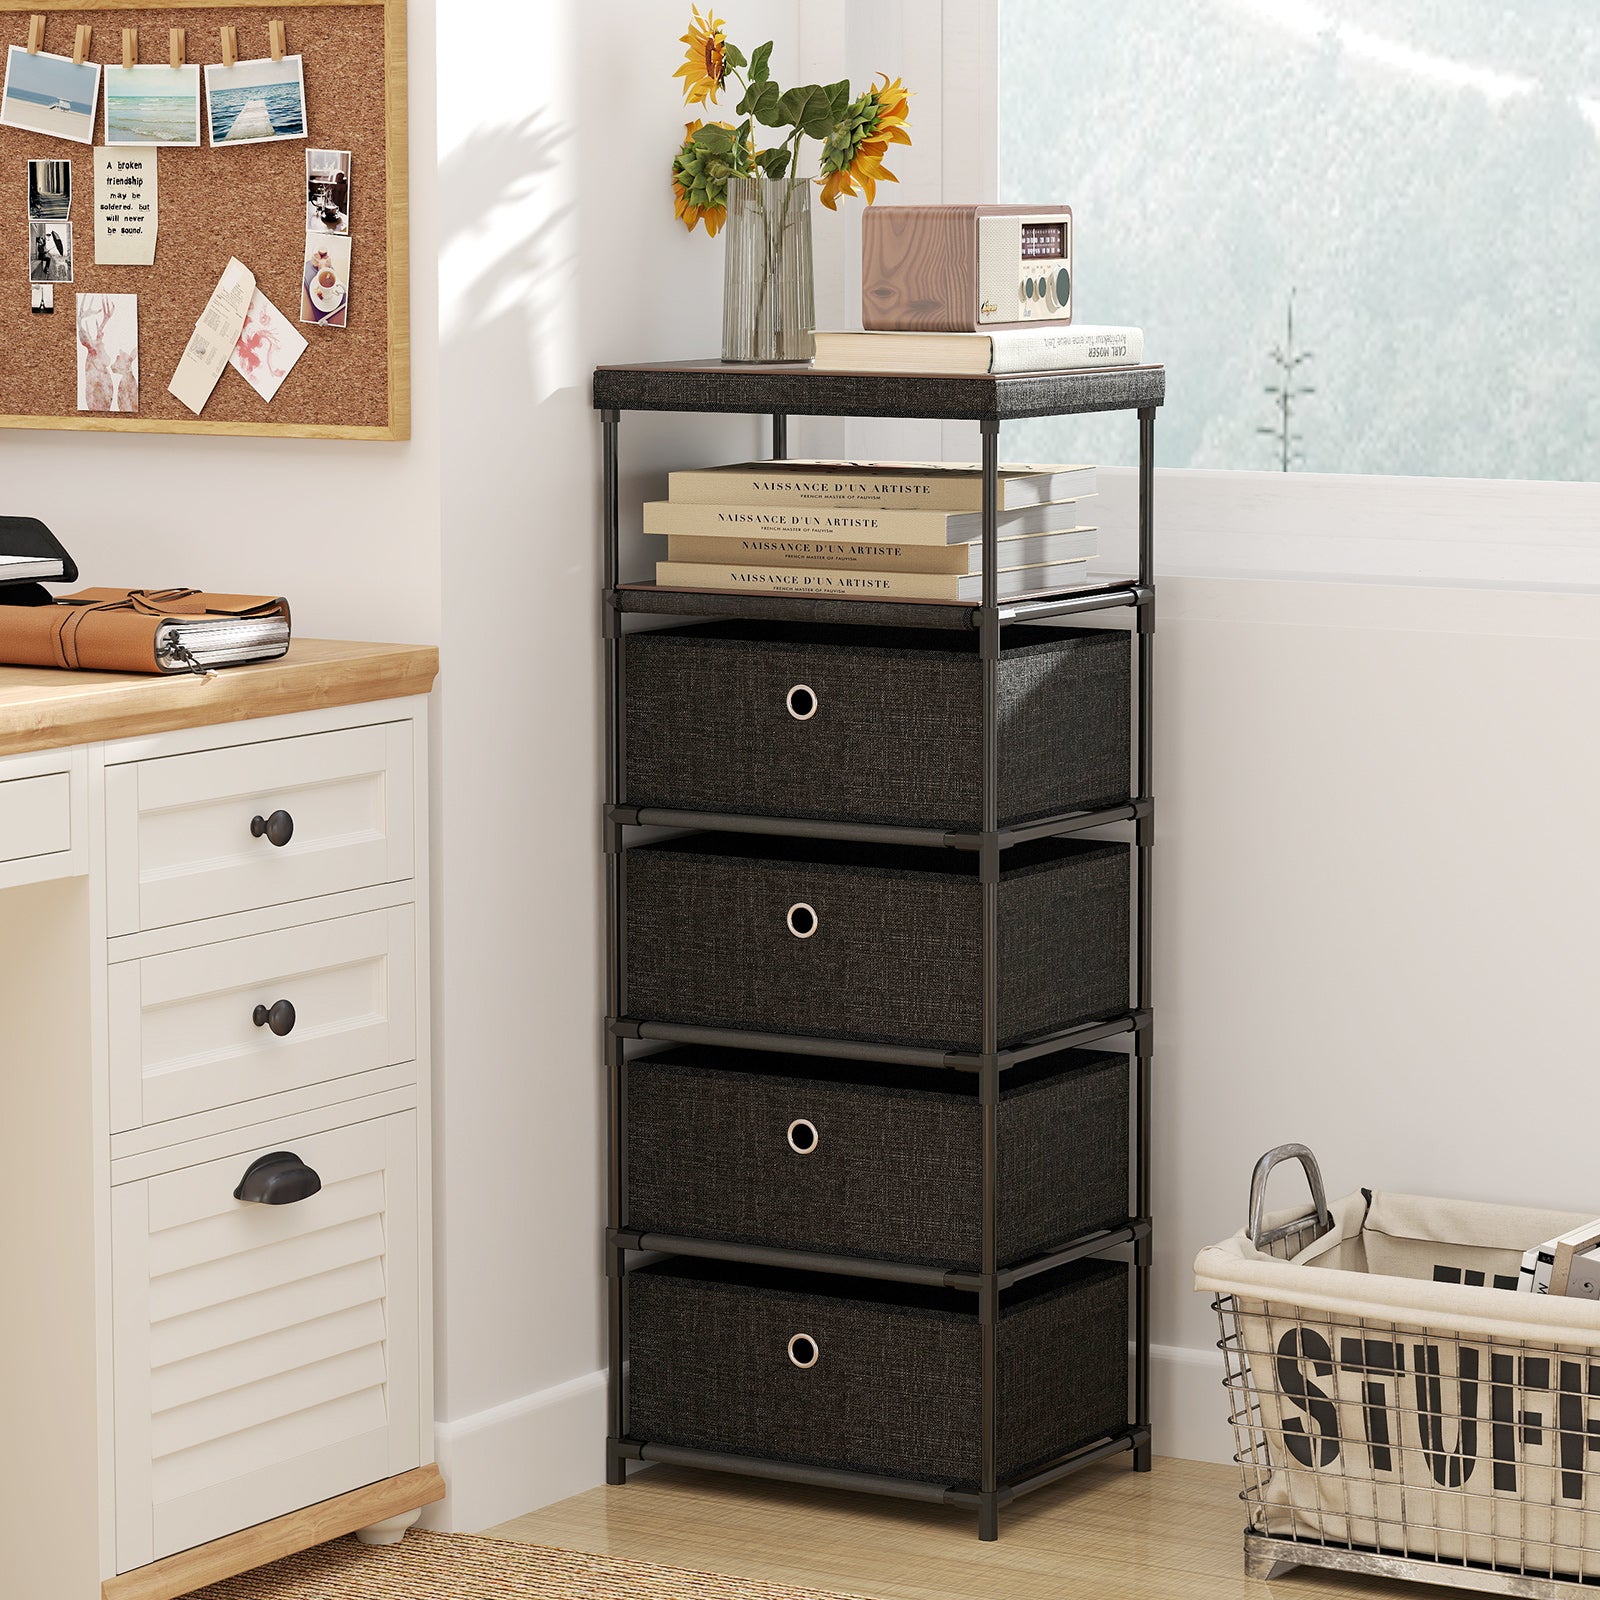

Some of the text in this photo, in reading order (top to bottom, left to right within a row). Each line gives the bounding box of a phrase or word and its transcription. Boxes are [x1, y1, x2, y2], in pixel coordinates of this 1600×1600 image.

[106, 161, 142, 170] A broken
[106, 176, 143, 187] friendship
[109, 192, 127, 200] may
[138, 203, 150, 211] but
[105, 214, 120, 222] will
[1087, 346, 1127, 358] CARL MOSER
[752, 482, 931, 494] NAISSANCE D'UN ARTISTE
[718, 513, 879, 528] NAISSANCE D'UN ARTISTE
[742, 541, 902, 556] NAISSANCE D'UN ARTISTE
[730, 573, 891, 589] NAISSANCE D'UN ARTISTE
